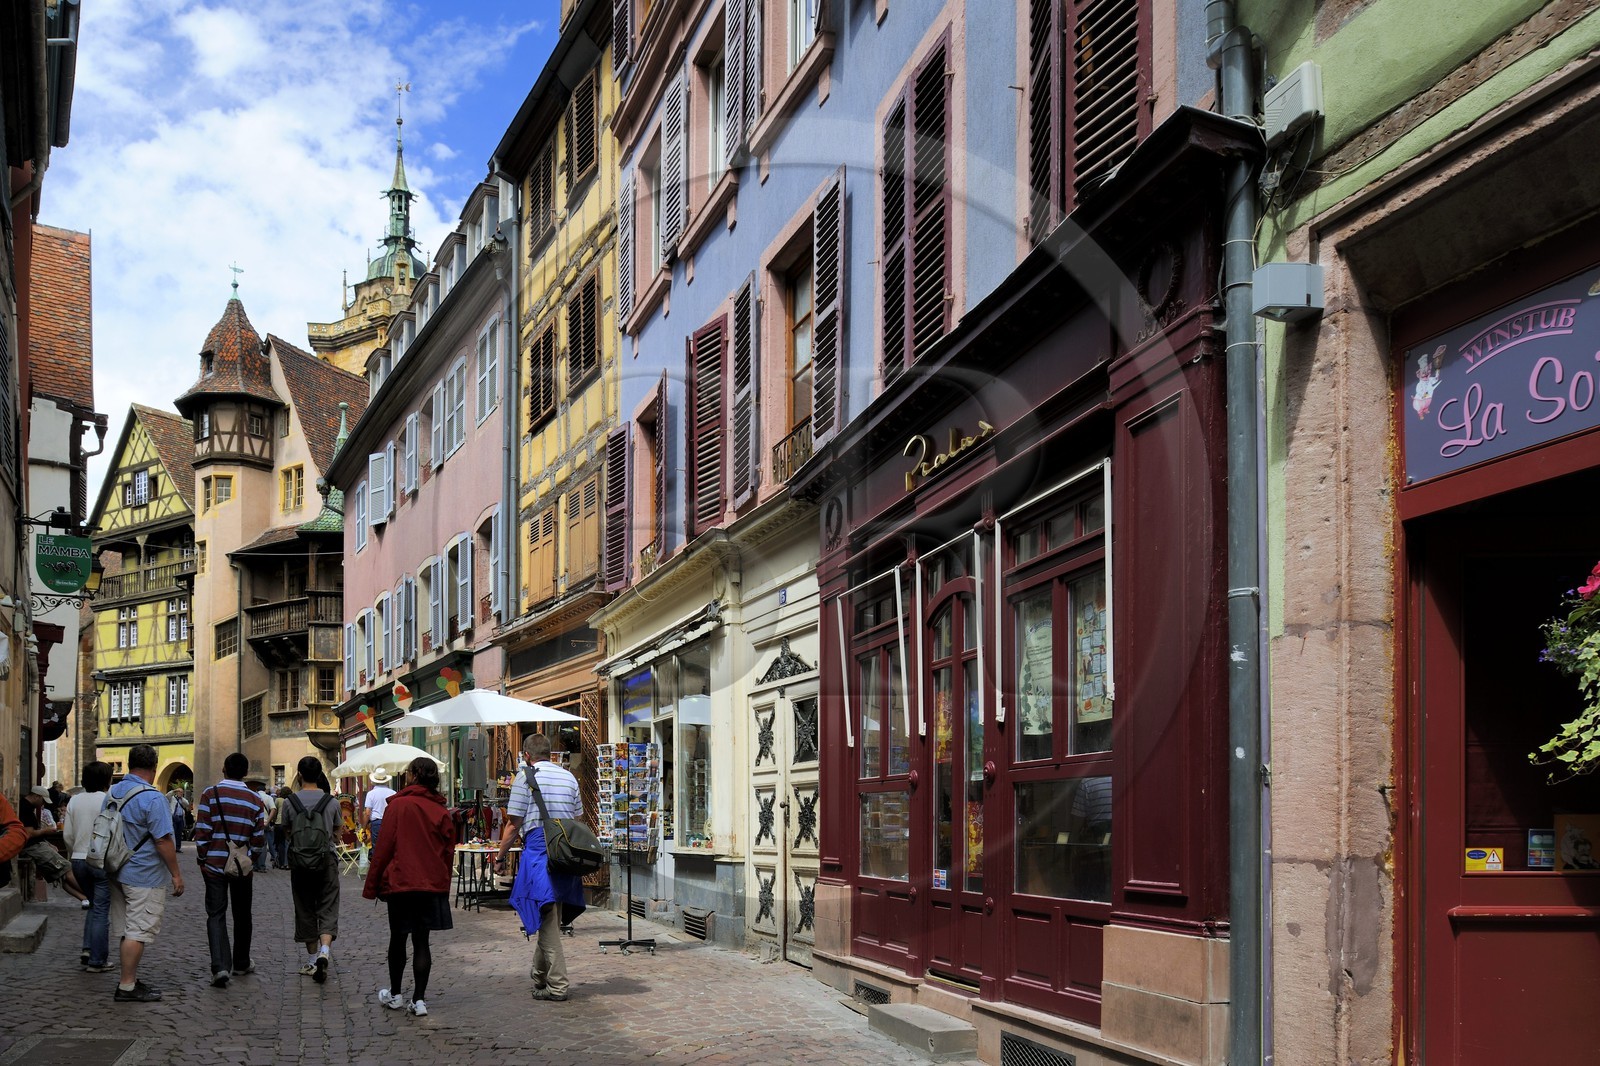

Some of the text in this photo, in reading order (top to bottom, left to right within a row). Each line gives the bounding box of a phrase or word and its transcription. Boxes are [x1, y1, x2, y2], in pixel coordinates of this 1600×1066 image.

[1462, 307, 1576, 364] WINSTUB
[1437, 350, 1600, 458] La So
[38, 545, 90, 558] MAMBA
[39, 535, 54, 544] LE
